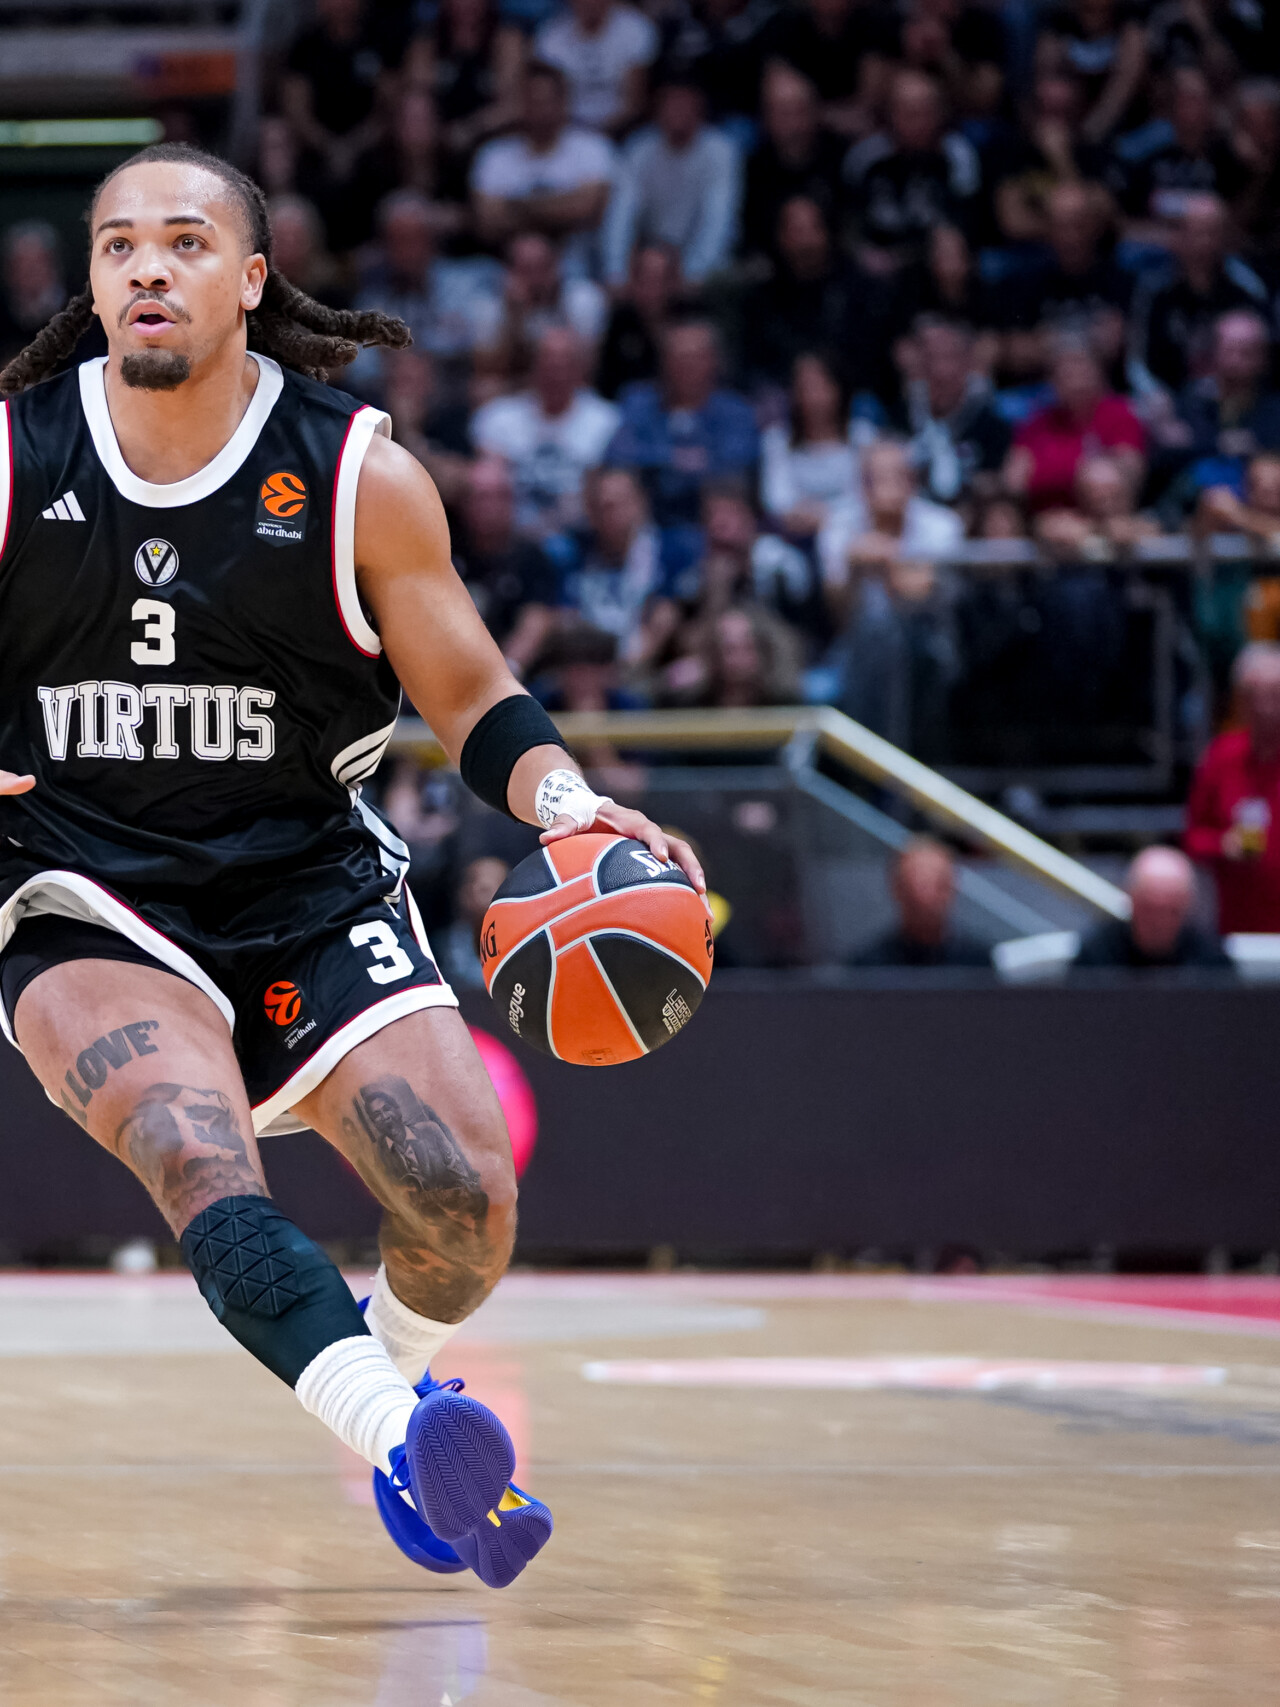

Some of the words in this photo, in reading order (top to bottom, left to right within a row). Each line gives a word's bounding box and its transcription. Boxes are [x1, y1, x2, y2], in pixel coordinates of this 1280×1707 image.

[256, 526, 275, 536] abu
[275, 528, 302, 540] dhabi
[130, 598, 176, 666] 3
[37, 680, 276, 761] VIRTUS
[348, 919, 415, 985] 3
